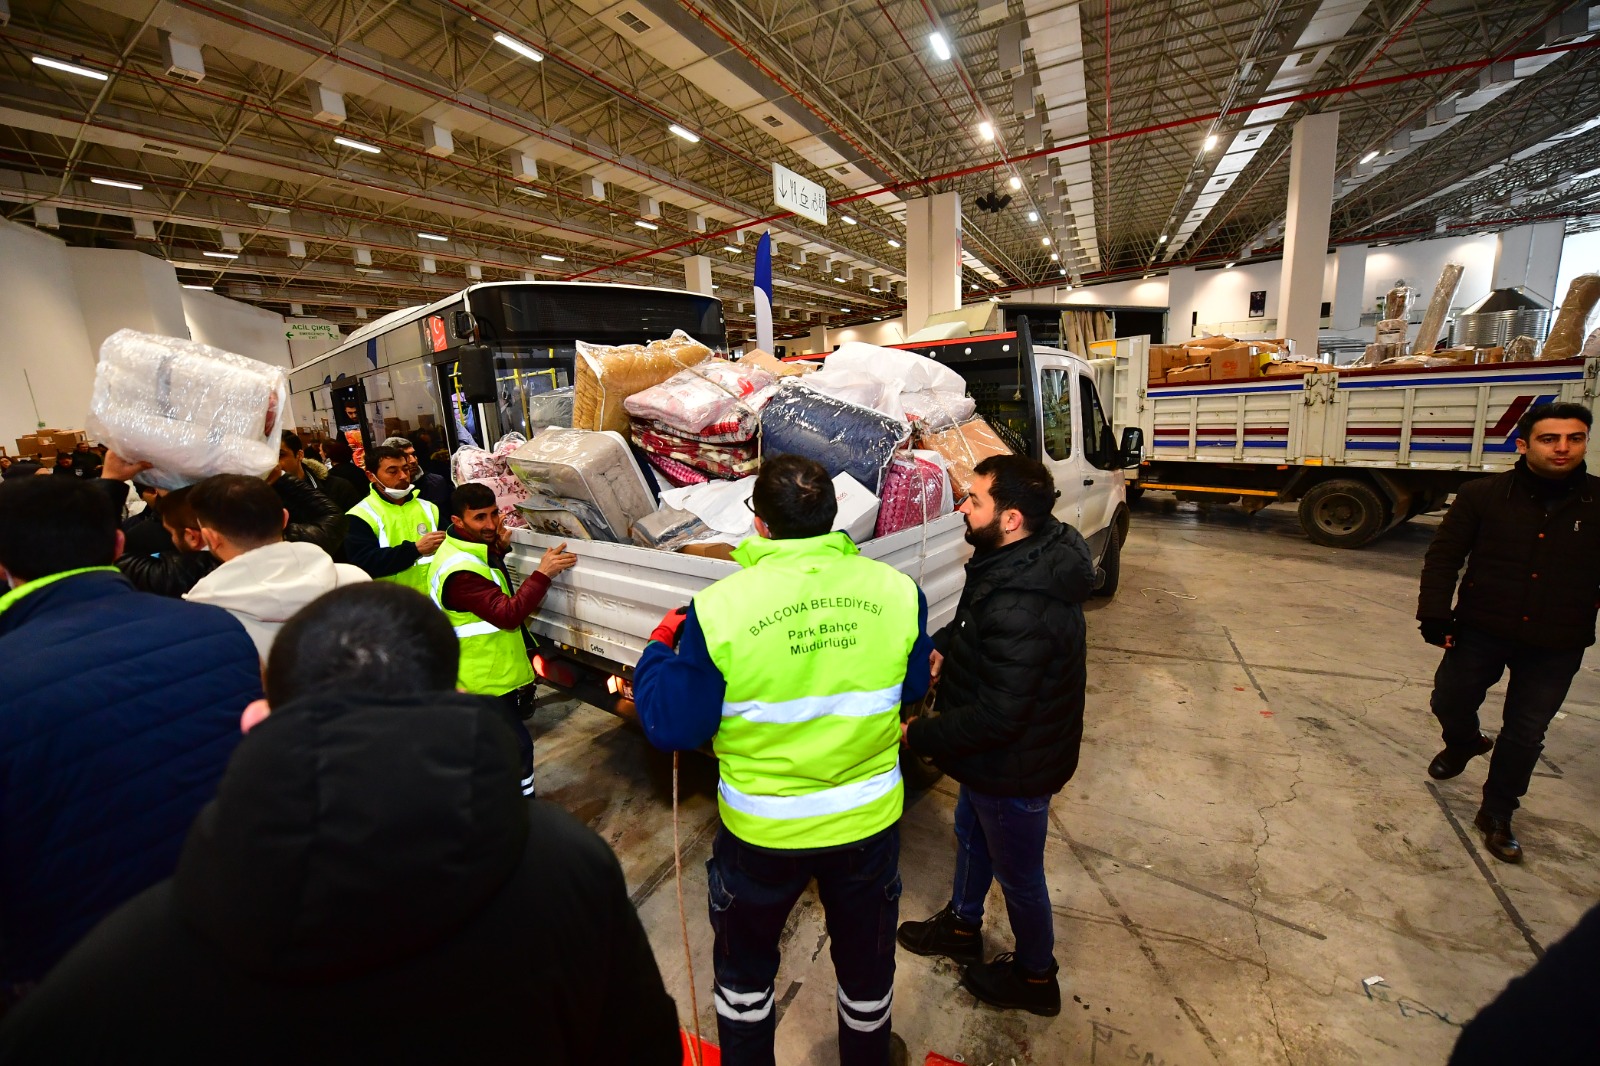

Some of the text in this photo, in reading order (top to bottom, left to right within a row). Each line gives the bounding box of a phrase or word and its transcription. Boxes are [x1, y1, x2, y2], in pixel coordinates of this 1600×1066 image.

[749, 596, 883, 636] BALÇOVA BELEDİYESİ
[788, 622, 858, 640] Park Bahçe
[790, 636, 857, 655] Müdürlüğü
